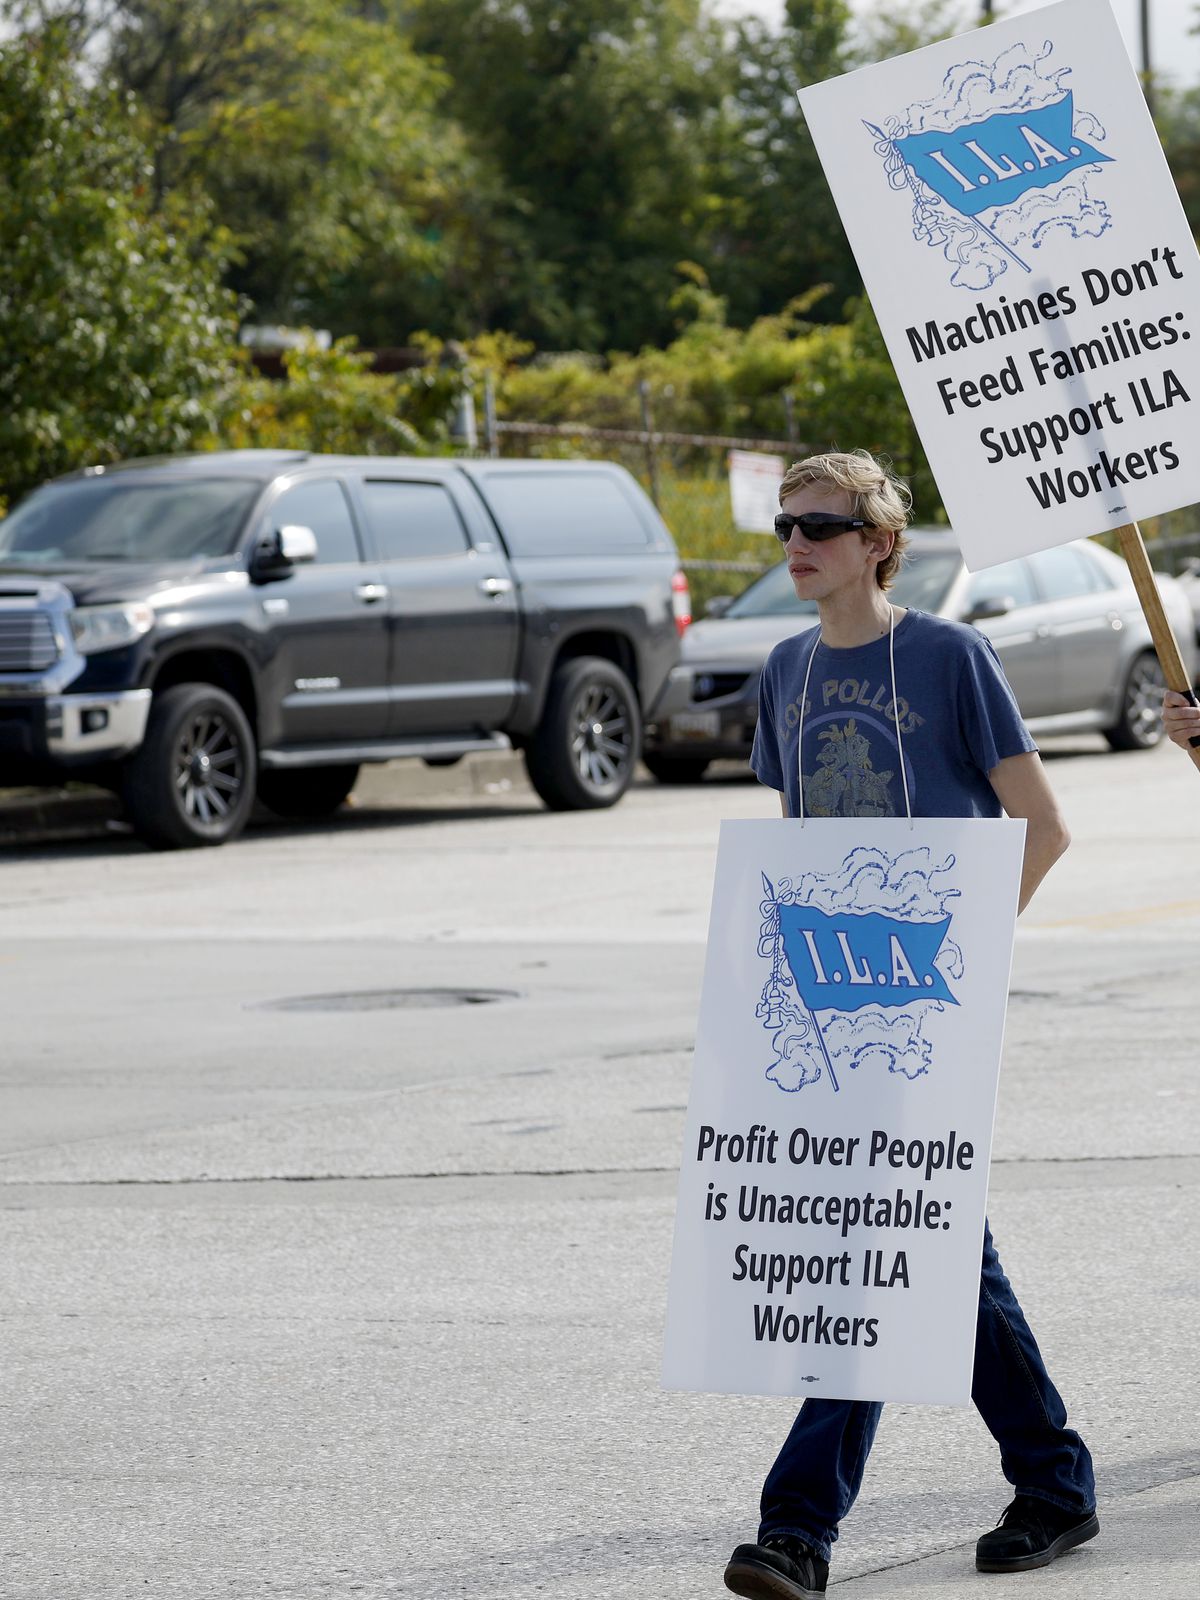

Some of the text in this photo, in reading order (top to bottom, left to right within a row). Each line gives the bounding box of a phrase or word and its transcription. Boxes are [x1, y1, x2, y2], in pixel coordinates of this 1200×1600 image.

[929, 125, 1081, 193] I.L.A.
[906, 247, 1184, 363] Machines Don't
[936, 312, 1191, 415] Feed Families:
[980, 369, 1191, 464] Support ILA
[1026, 441, 1180, 510] Workers
[822, 678, 926, 734] POLLOS
[799, 928, 933, 988] I.L.A.
[697, 1125, 973, 1180] Profit Over People
[705, 1183, 951, 1237] is Unacceptable:
[732, 1244, 910, 1294] Support ILA
[753, 1305, 879, 1347] Workers
